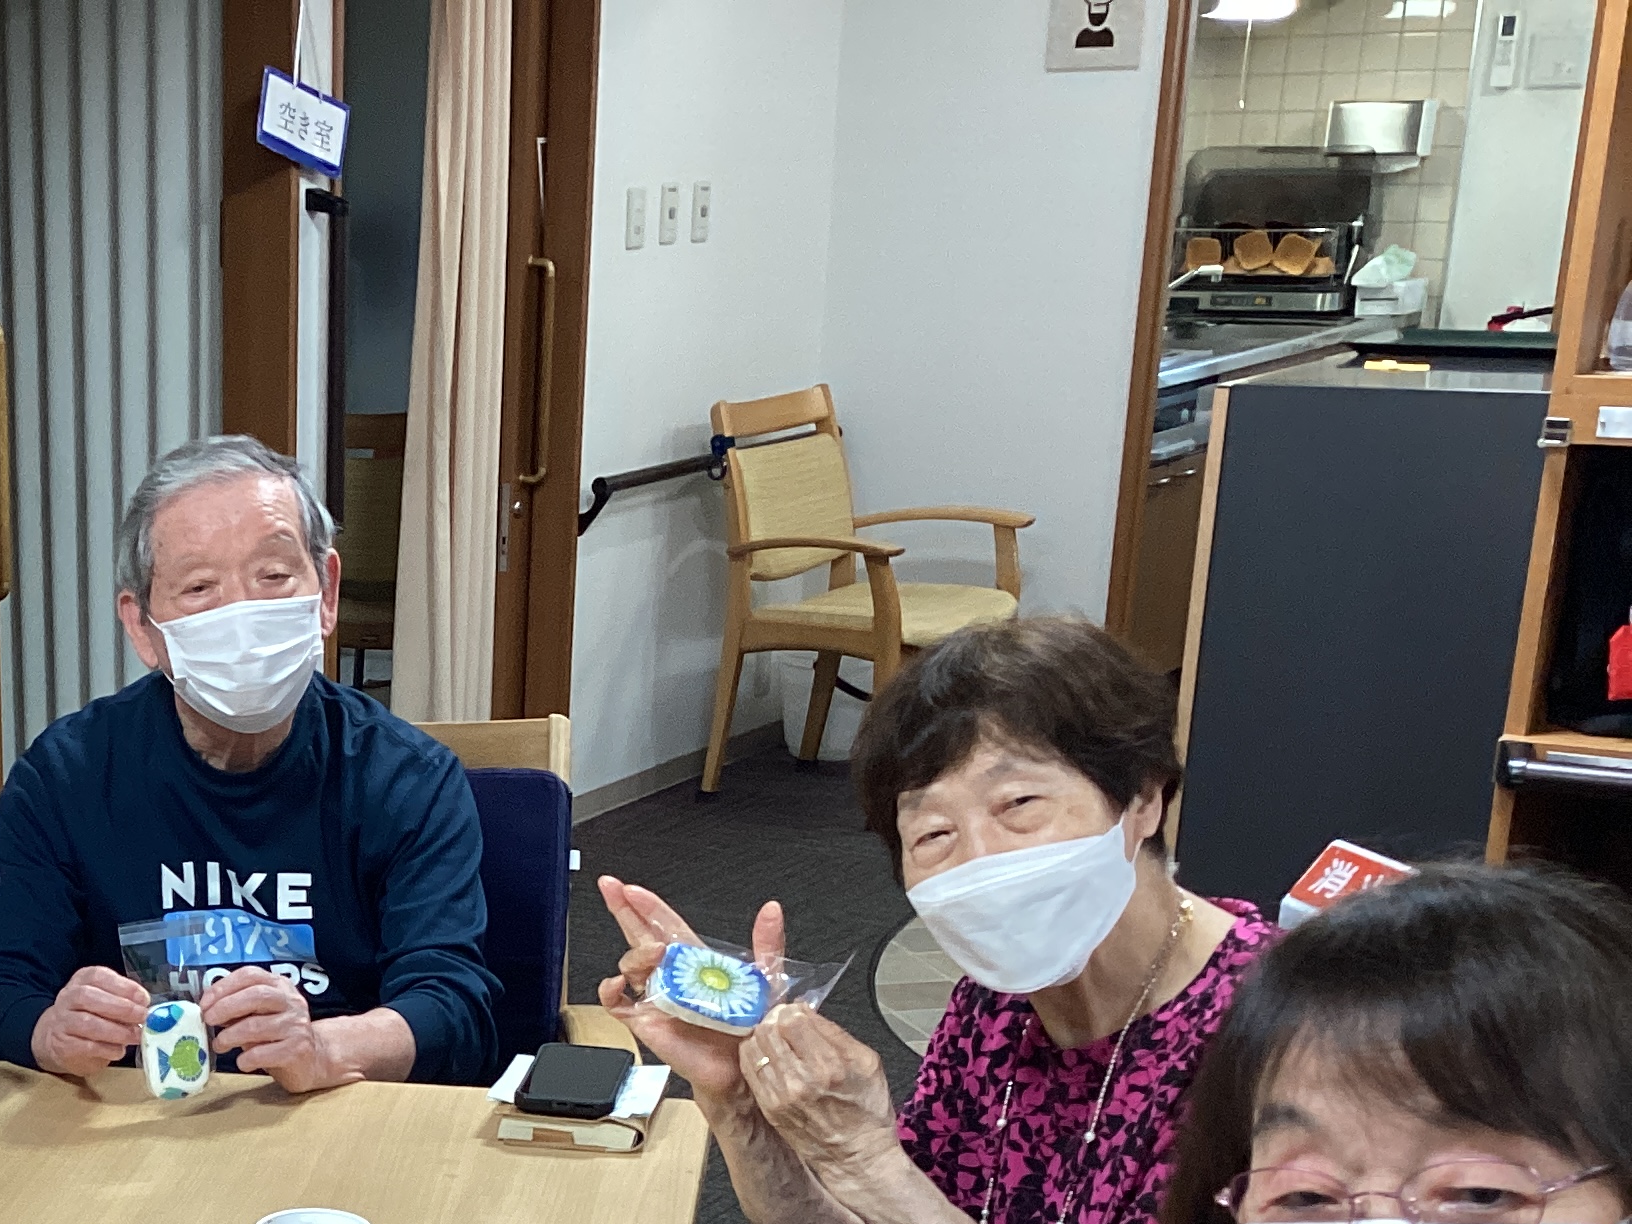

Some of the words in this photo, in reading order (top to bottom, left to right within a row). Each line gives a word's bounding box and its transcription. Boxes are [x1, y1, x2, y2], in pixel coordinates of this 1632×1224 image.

[276, 101, 334, 152] 空き室
[160, 861, 314, 921] NIKE
[169, 962, 331, 1000] HOPS
